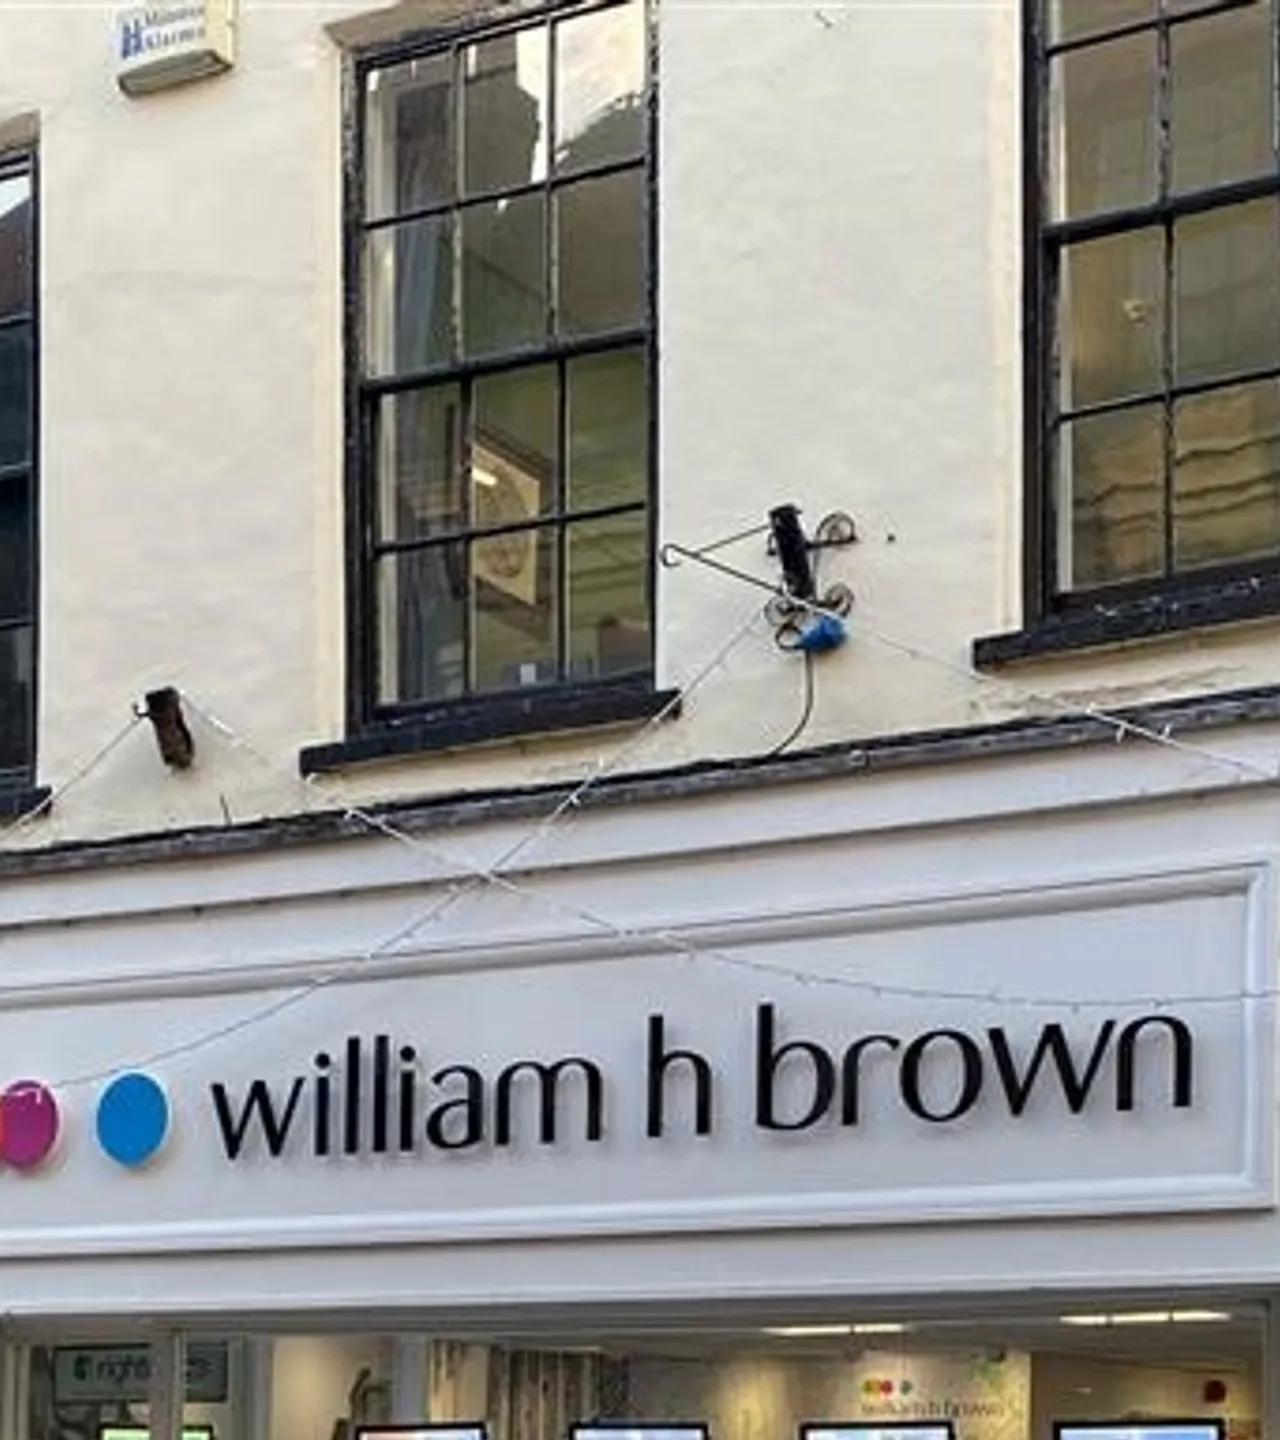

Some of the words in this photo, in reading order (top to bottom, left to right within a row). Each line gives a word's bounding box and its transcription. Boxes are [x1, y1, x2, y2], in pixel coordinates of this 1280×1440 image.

[211, 1034, 603, 1160] william
[647, 1014, 712, 1138] h
[755, 1003, 1193, 1131] brown
